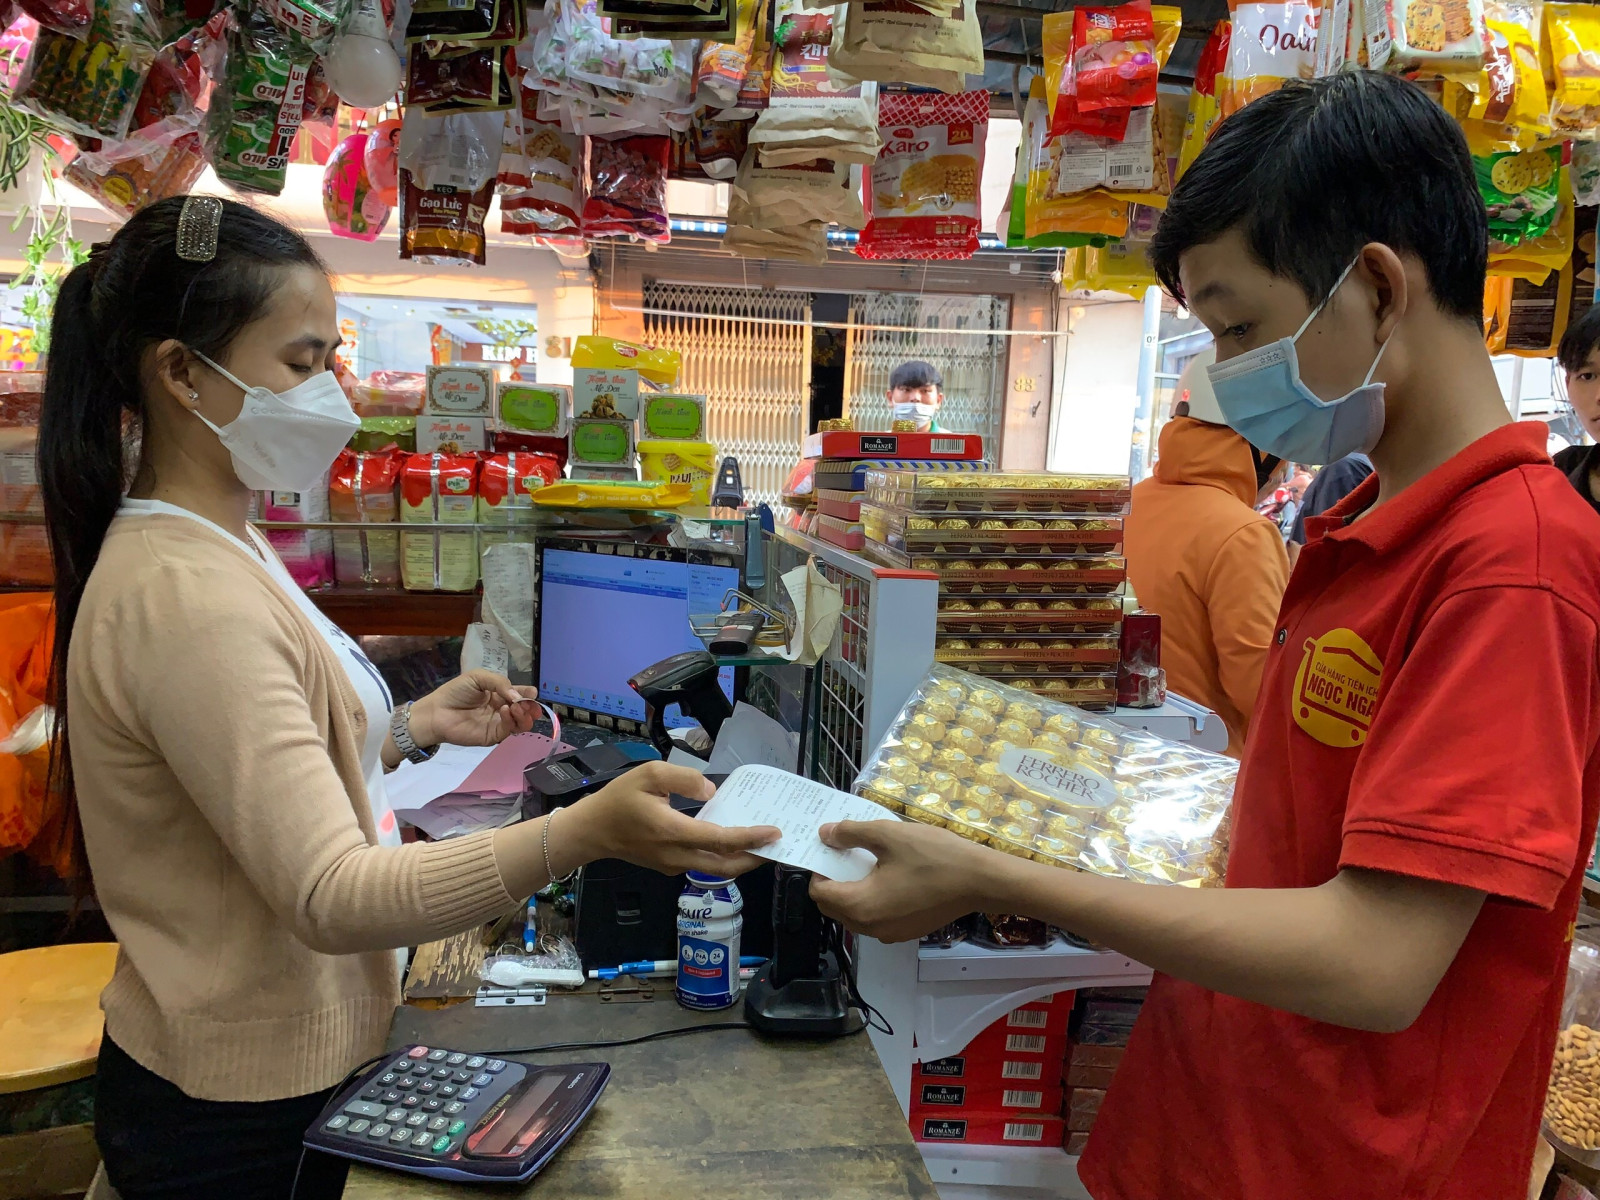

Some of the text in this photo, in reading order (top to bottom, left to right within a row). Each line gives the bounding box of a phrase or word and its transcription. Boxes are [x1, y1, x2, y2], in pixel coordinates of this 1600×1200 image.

[880, 140, 930, 159] Karo
[1307, 673, 1343, 704] NGỌC
[1020, 755, 1100, 790] FERRERO
[1016, 764, 1095, 801] ROCHER
[926, 1064, 959, 1073] ROMANZE
[382, 1073, 394, 1082] 00
[926, 1092, 960, 1100] ROMANZE
[928, 1127, 961, 1135] ROMANZE
